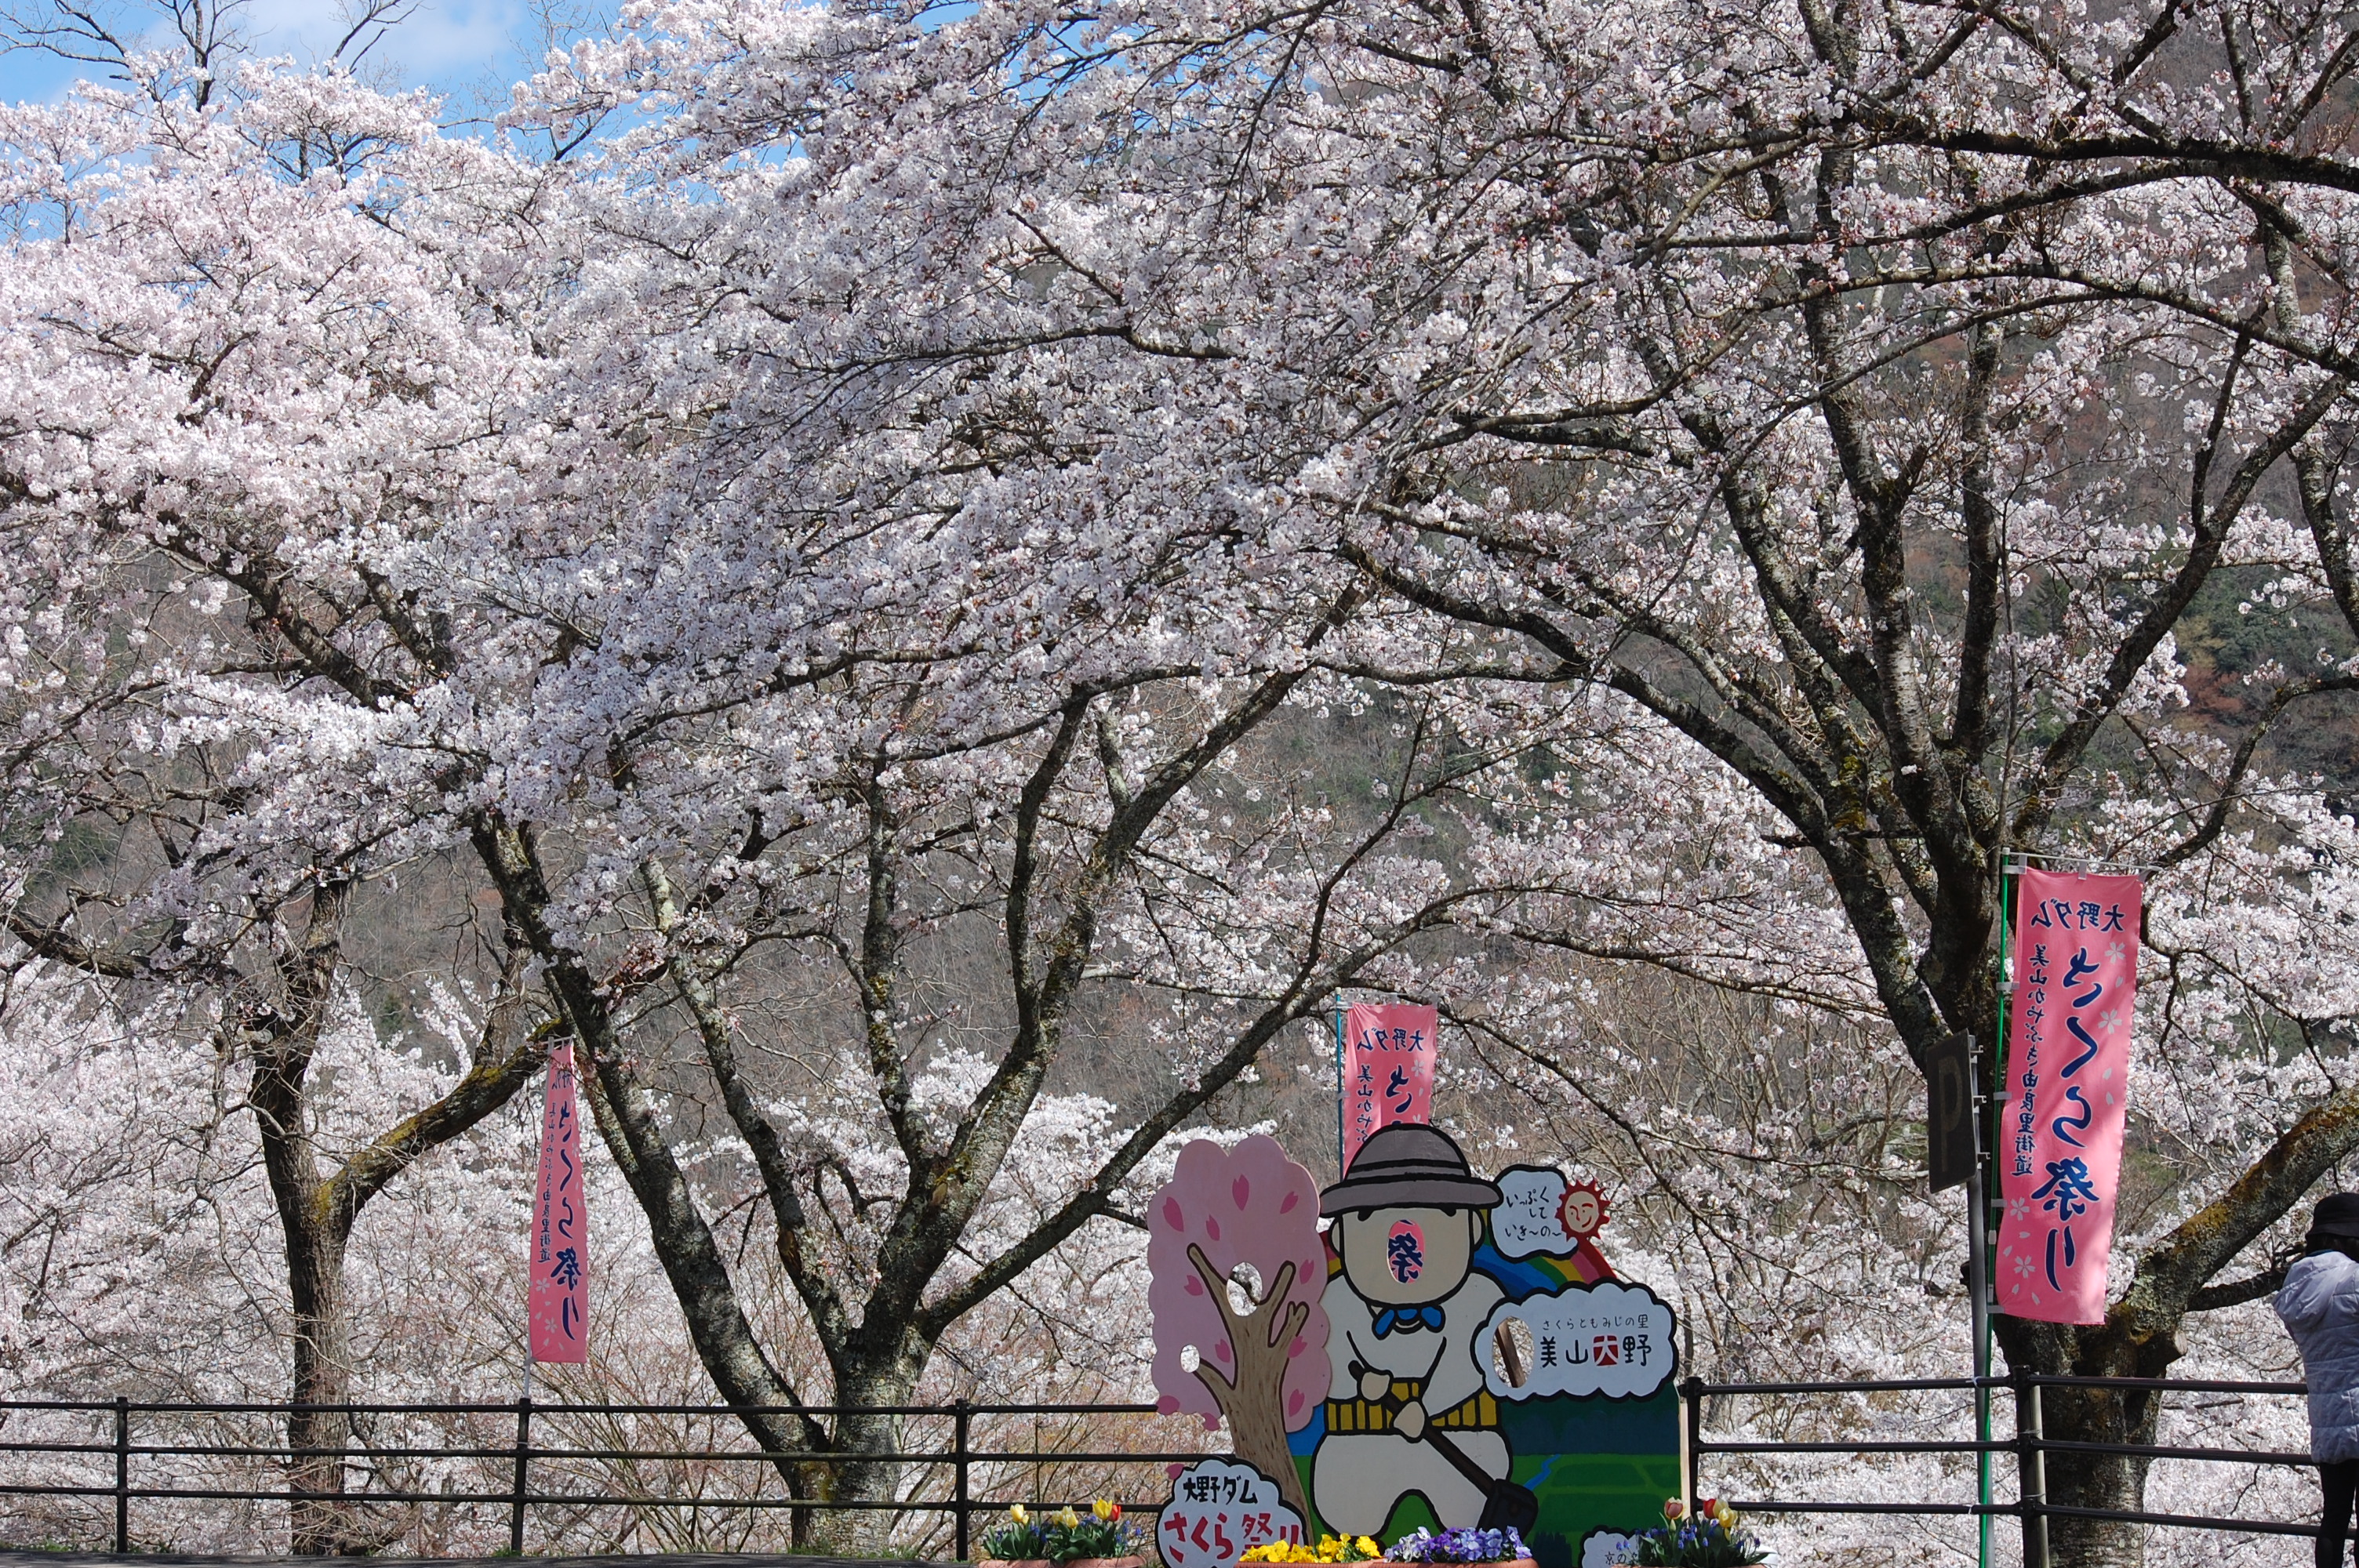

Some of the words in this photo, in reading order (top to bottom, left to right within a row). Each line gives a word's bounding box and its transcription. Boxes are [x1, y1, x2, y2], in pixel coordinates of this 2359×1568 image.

[1938, 1054, 1963, 1173] P
[1506, 1185, 1550, 1208] いっぷく
[1528, 1207, 1547, 1219] して
[1542, 1313, 1649, 1331] さくらともみじの里
[1539, 1334, 1652, 1368] 美山大野
[1183, 1475, 1259, 1505] 大野ダム
